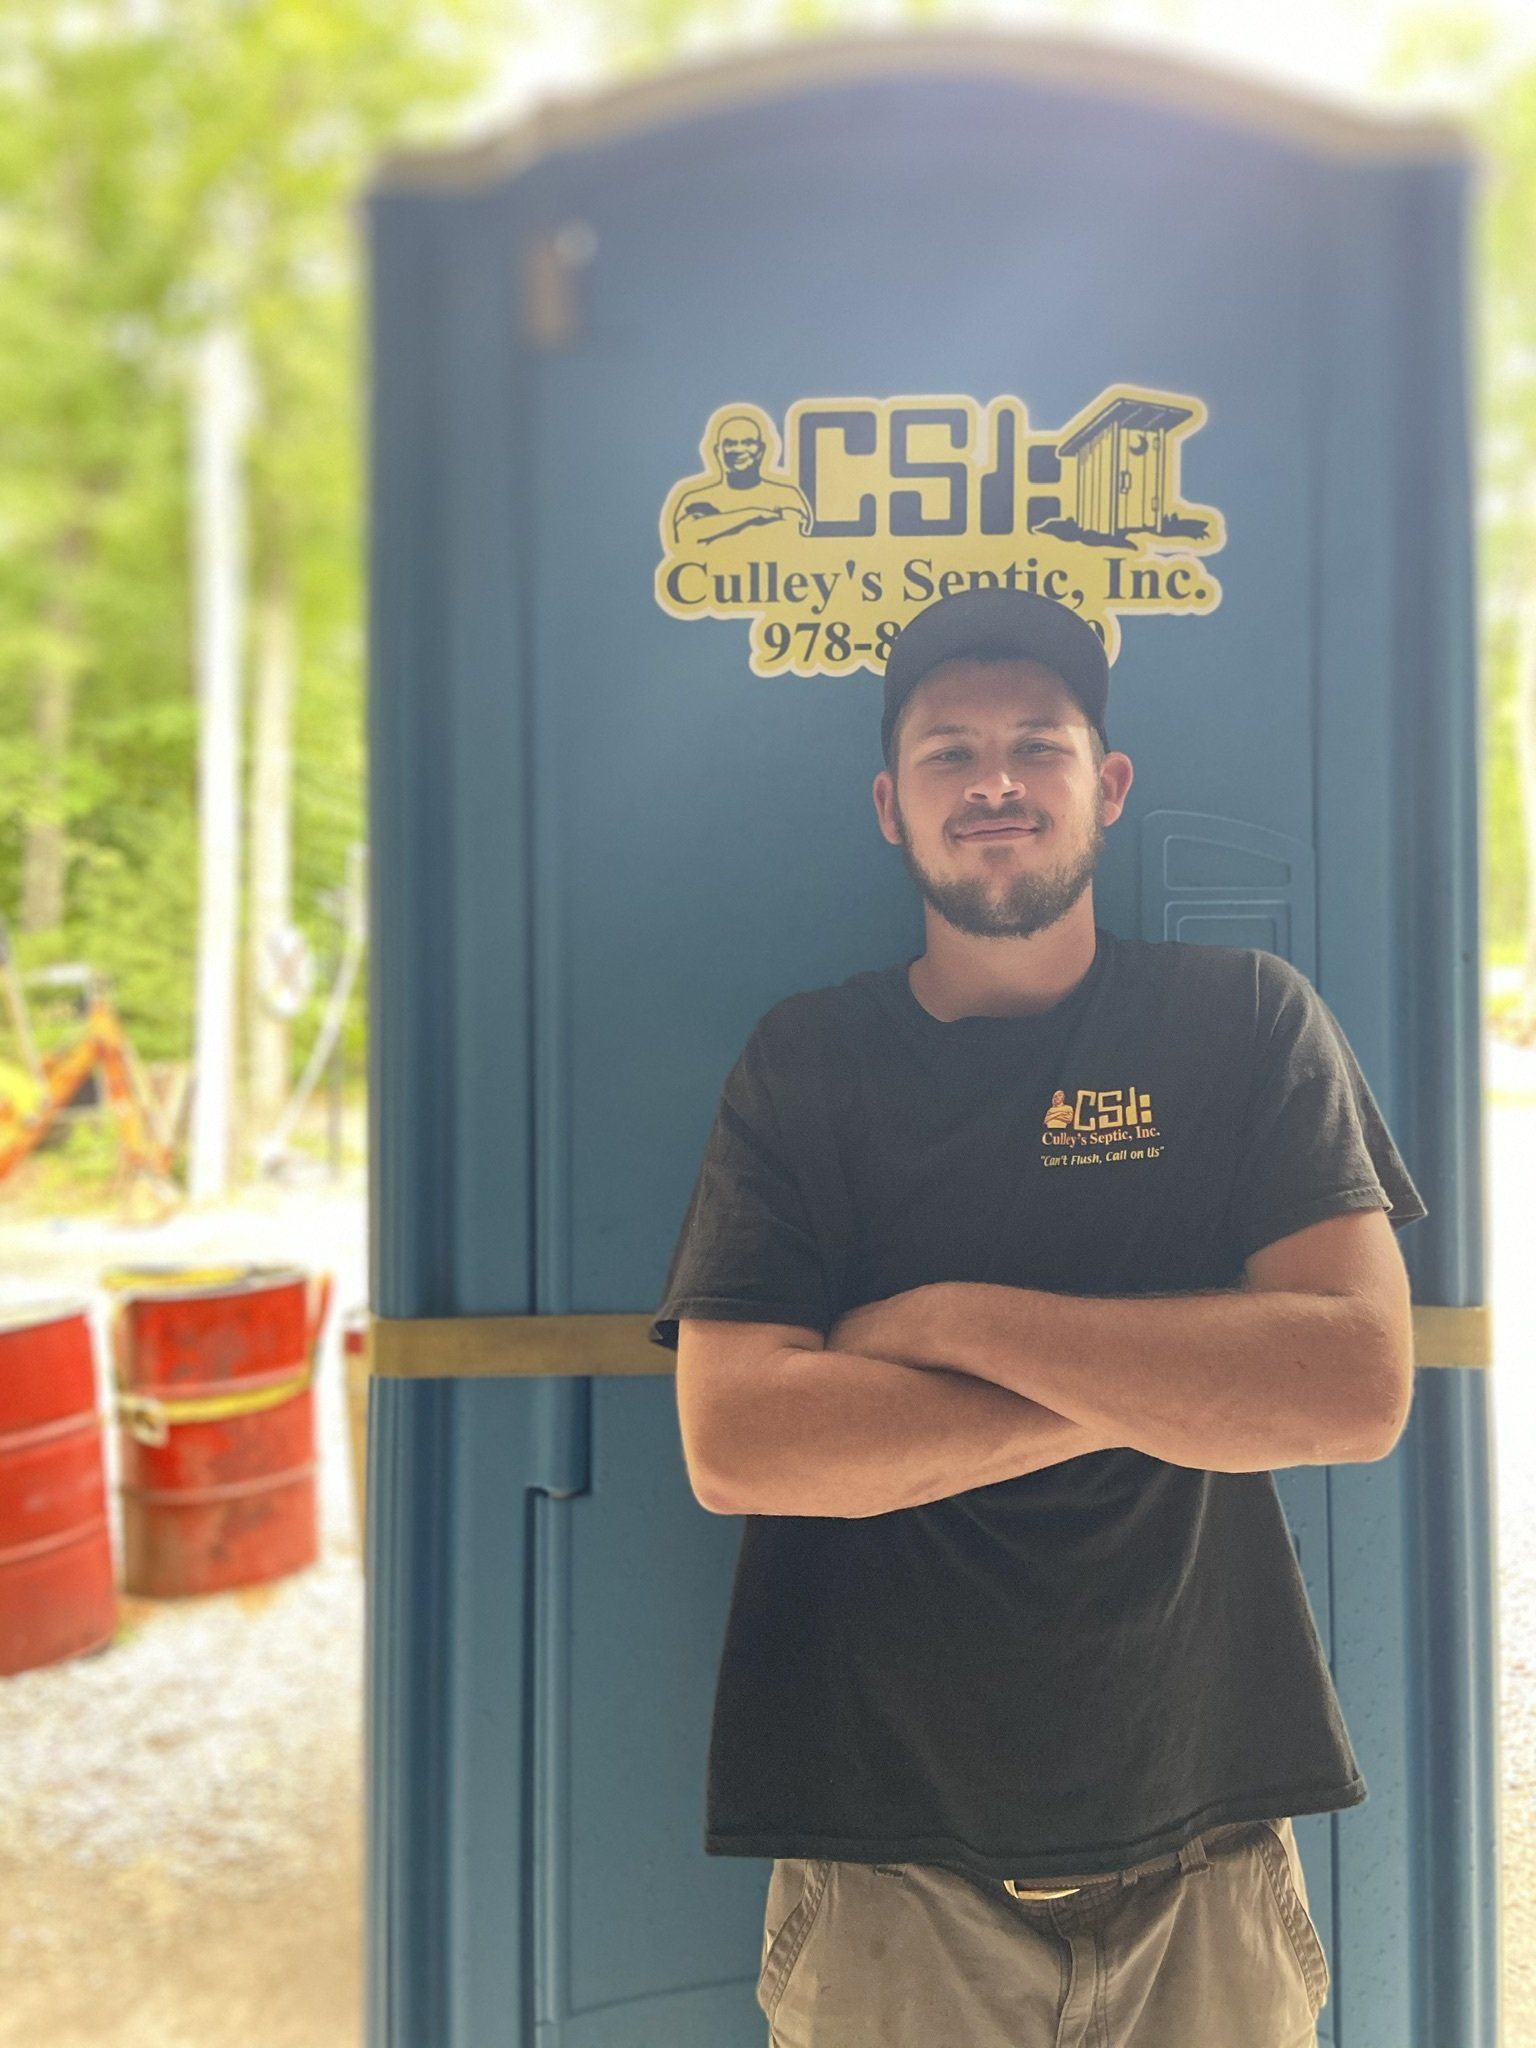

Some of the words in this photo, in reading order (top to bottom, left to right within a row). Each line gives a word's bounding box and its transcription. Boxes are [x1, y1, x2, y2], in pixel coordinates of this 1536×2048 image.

[666, 559, 883, 615] Culley's
[1103, 557, 1207, 601] Inc.
[1041, 1131, 1088, 1148] Culley's
[1089, 1129, 1133, 1146] Septic,
[1135, 1125, 1160, 1139] Inc.
[1070, 1153, 1102, 1166] Flush,
[1105, 1149, 1127, 1162] Call
[1130, 1150, 1144, 1160] on
